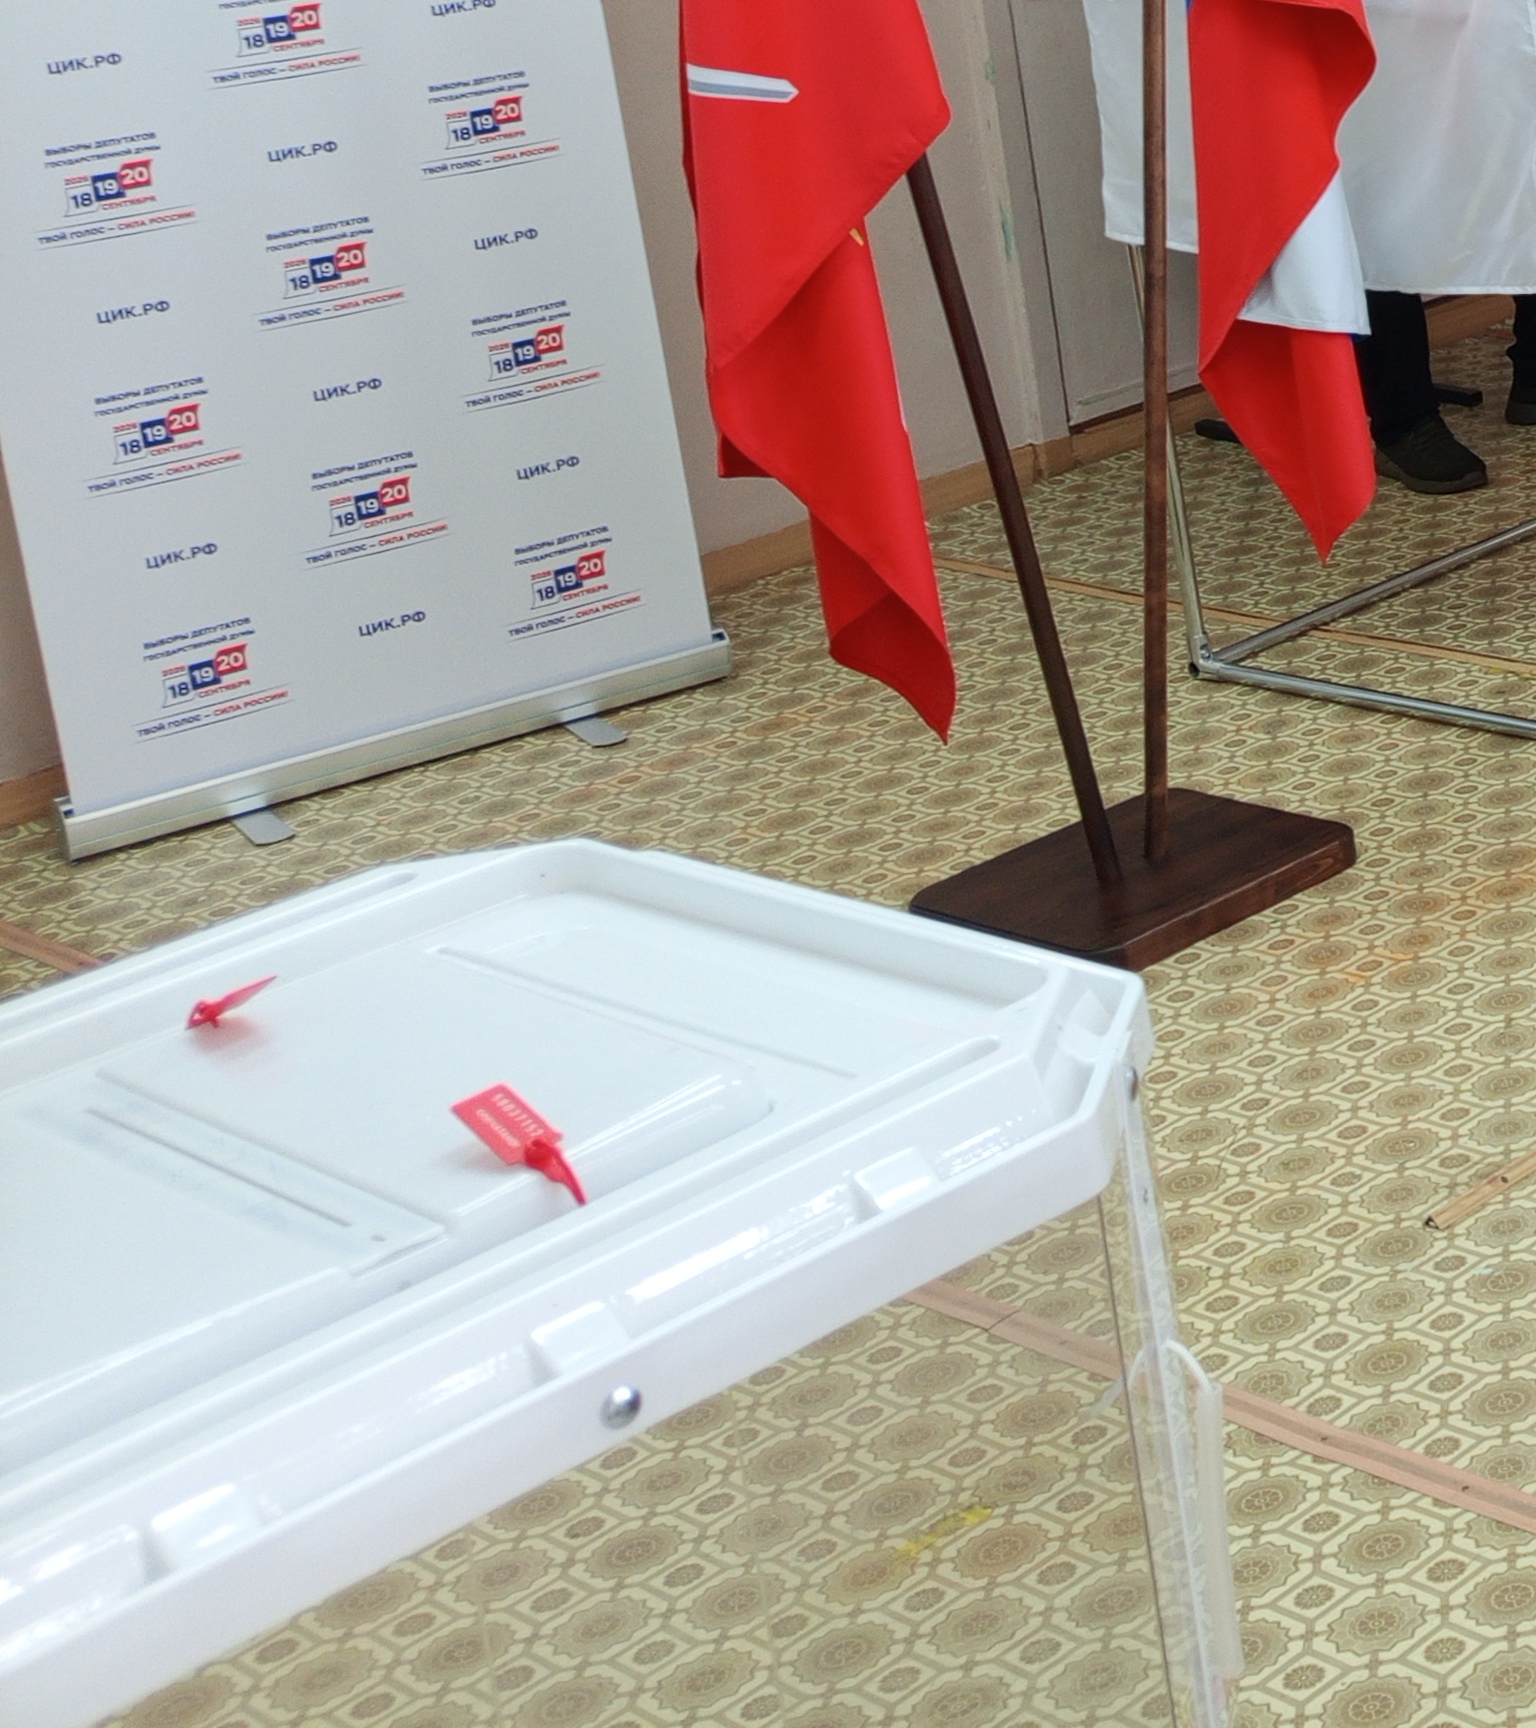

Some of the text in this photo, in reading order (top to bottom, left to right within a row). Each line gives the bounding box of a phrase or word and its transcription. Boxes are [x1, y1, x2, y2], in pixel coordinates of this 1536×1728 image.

[47, 53, 122, 76] ЦИК.РФ
[267, 141, 338, 163] ЦИК.РФ
[121, 167, 149, 183] 20
[70, 193, 93, 209] 18
[474, 228, 539, 252] ЦИК.РФ
[336, 250, 362, 266] 20
[289, 276, 310, 290] 18
[96, 300, 170, 324] ЦИК.РФ
[313, 378, 382, 402] ЦИК.РФ
[517, 456, 580, 481] ЦИК.РФ
[145, 542, 217, 569] ЦИК.РФ
[578, 560, 601, 575] 20
[537, 587, 555, 601] 18
[358, 611, 426, 638] ЦИК.РФ
[216, 654, 244, 670] 20
[168, 683, 190, 698] 18
